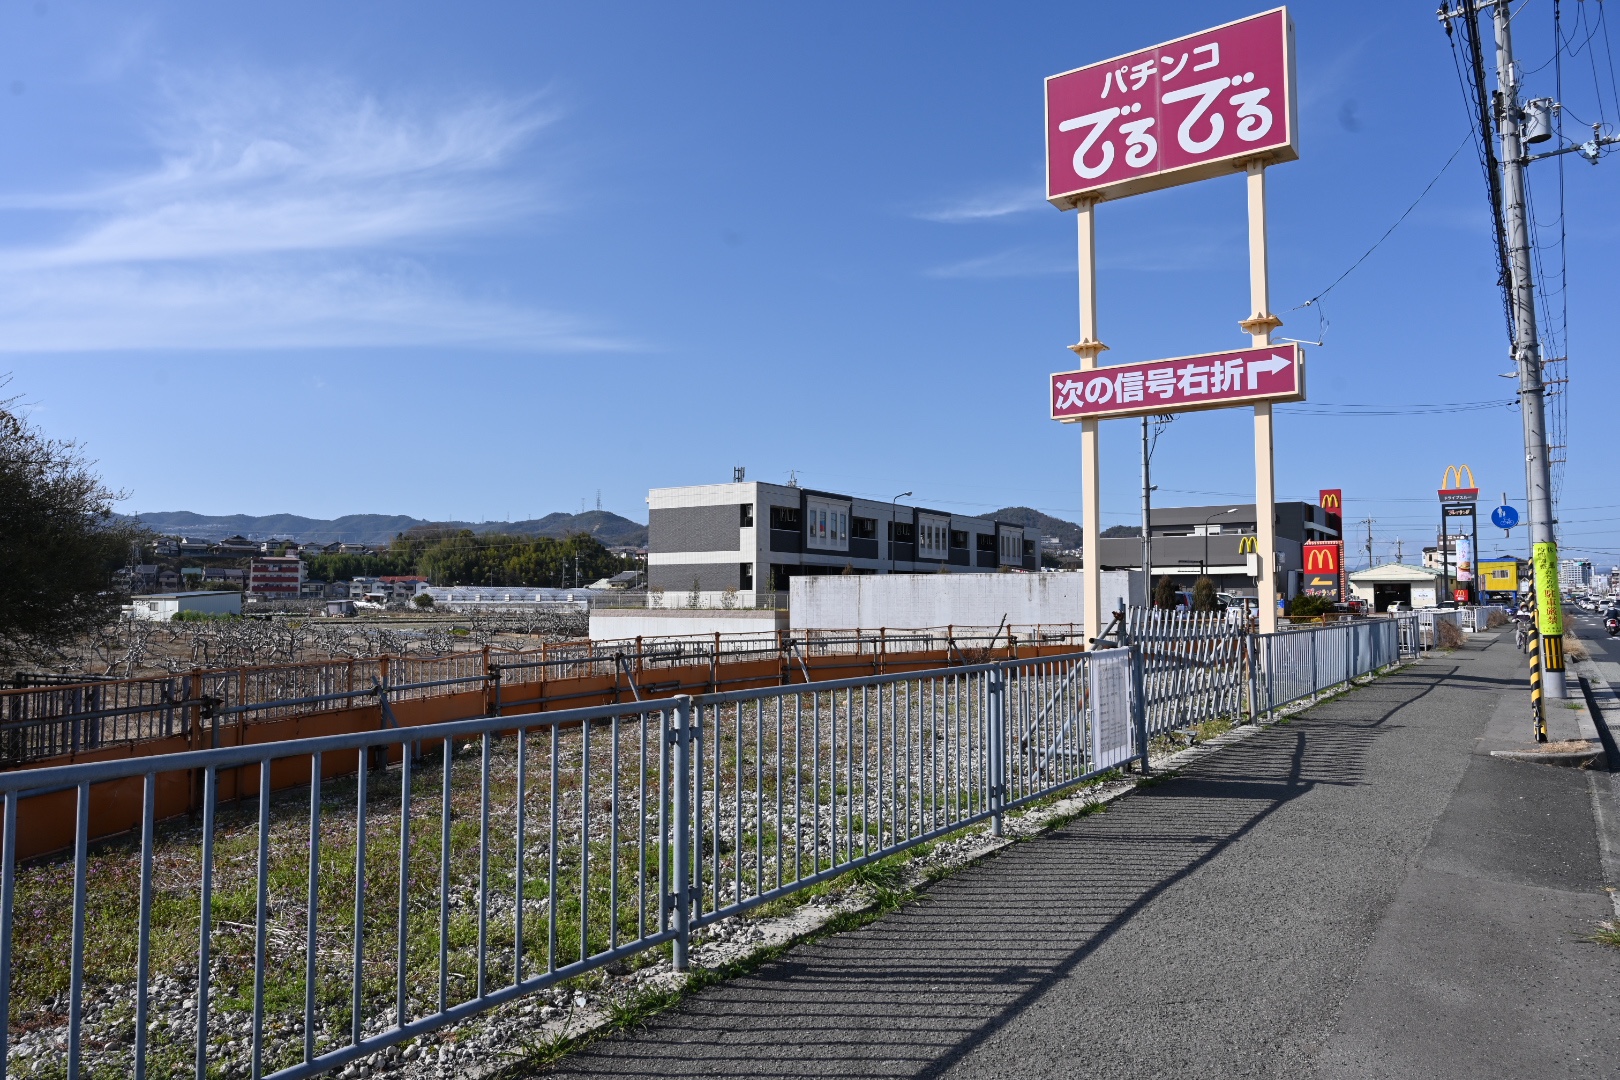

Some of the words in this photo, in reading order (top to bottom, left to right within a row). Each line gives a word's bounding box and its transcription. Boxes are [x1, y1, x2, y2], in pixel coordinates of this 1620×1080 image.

[1100, 42, 1220, 99] パチンコ
[1058, 71, 1273, 180] でるでる
[1055, 357, 1244, 410] 次の信号右折
